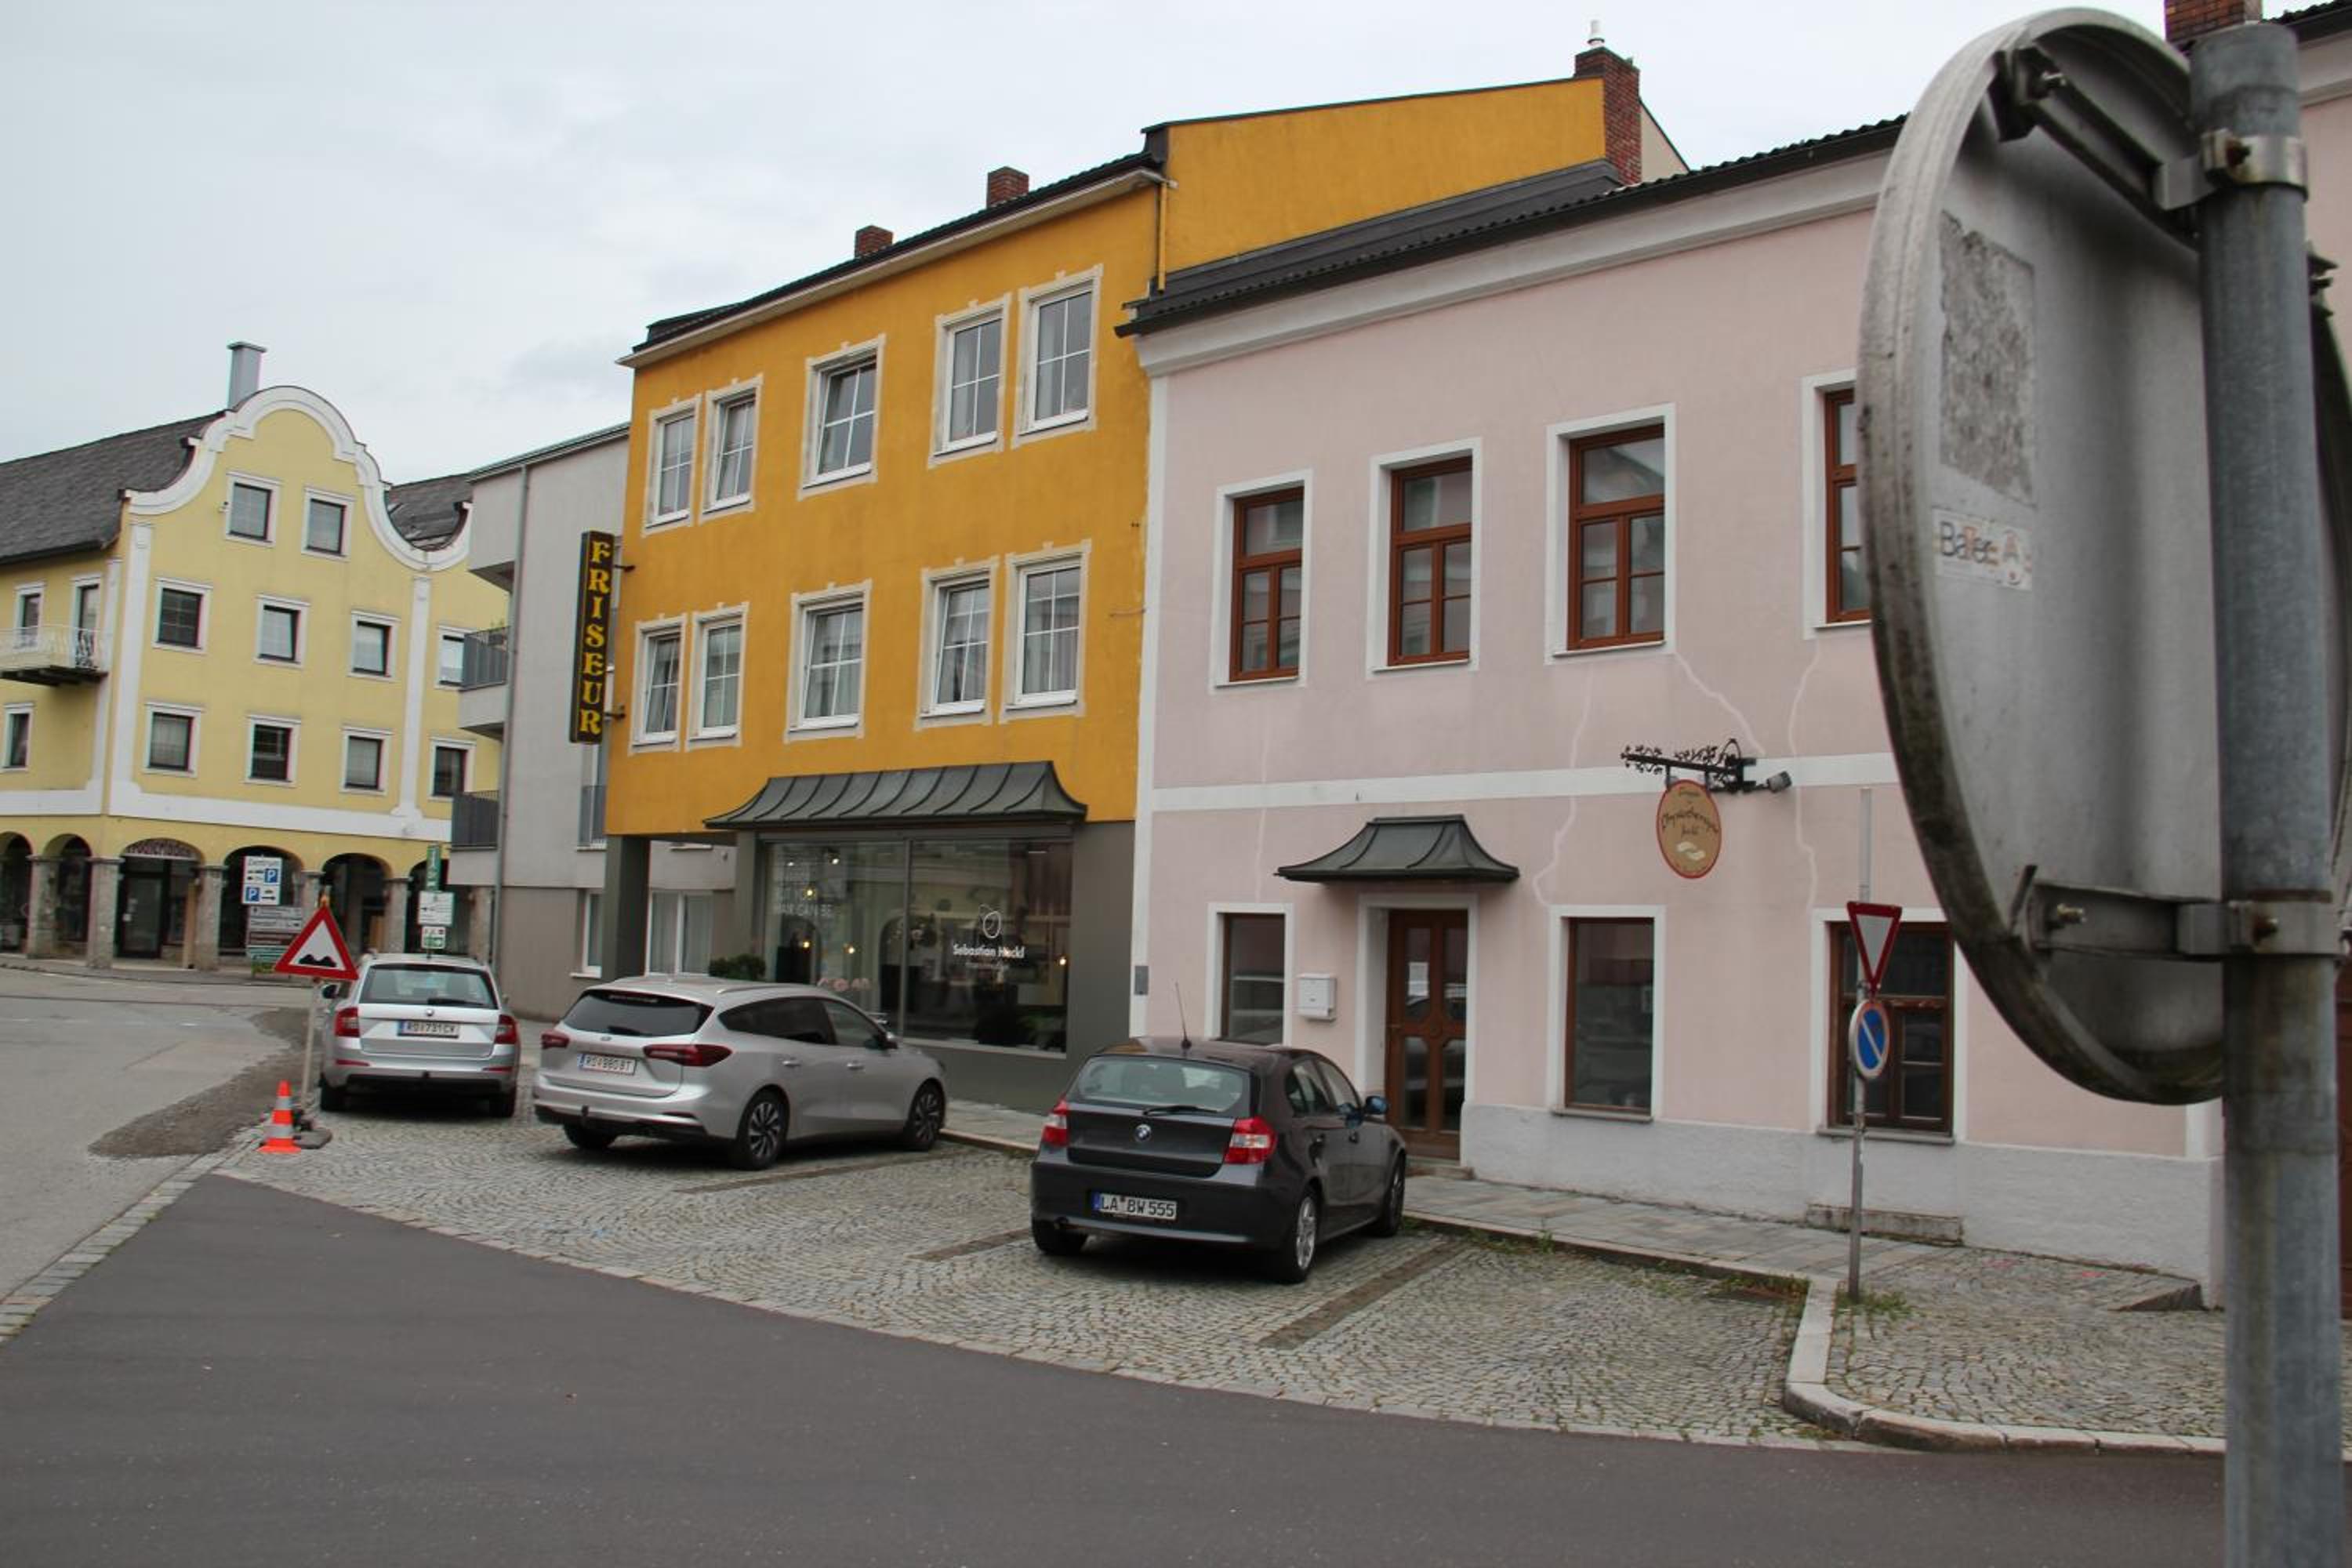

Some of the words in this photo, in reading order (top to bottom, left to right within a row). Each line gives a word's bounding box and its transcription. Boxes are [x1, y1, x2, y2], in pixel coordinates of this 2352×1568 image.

[579, 540, 612, 735] FRISEUR
[953, 943, 996, 956] Sebastian
[1101, 1196, 1117, 1211] LA
[1127, 1199, 1145, 1214] BW
[1148, 1200, 1174, 1218] 555
